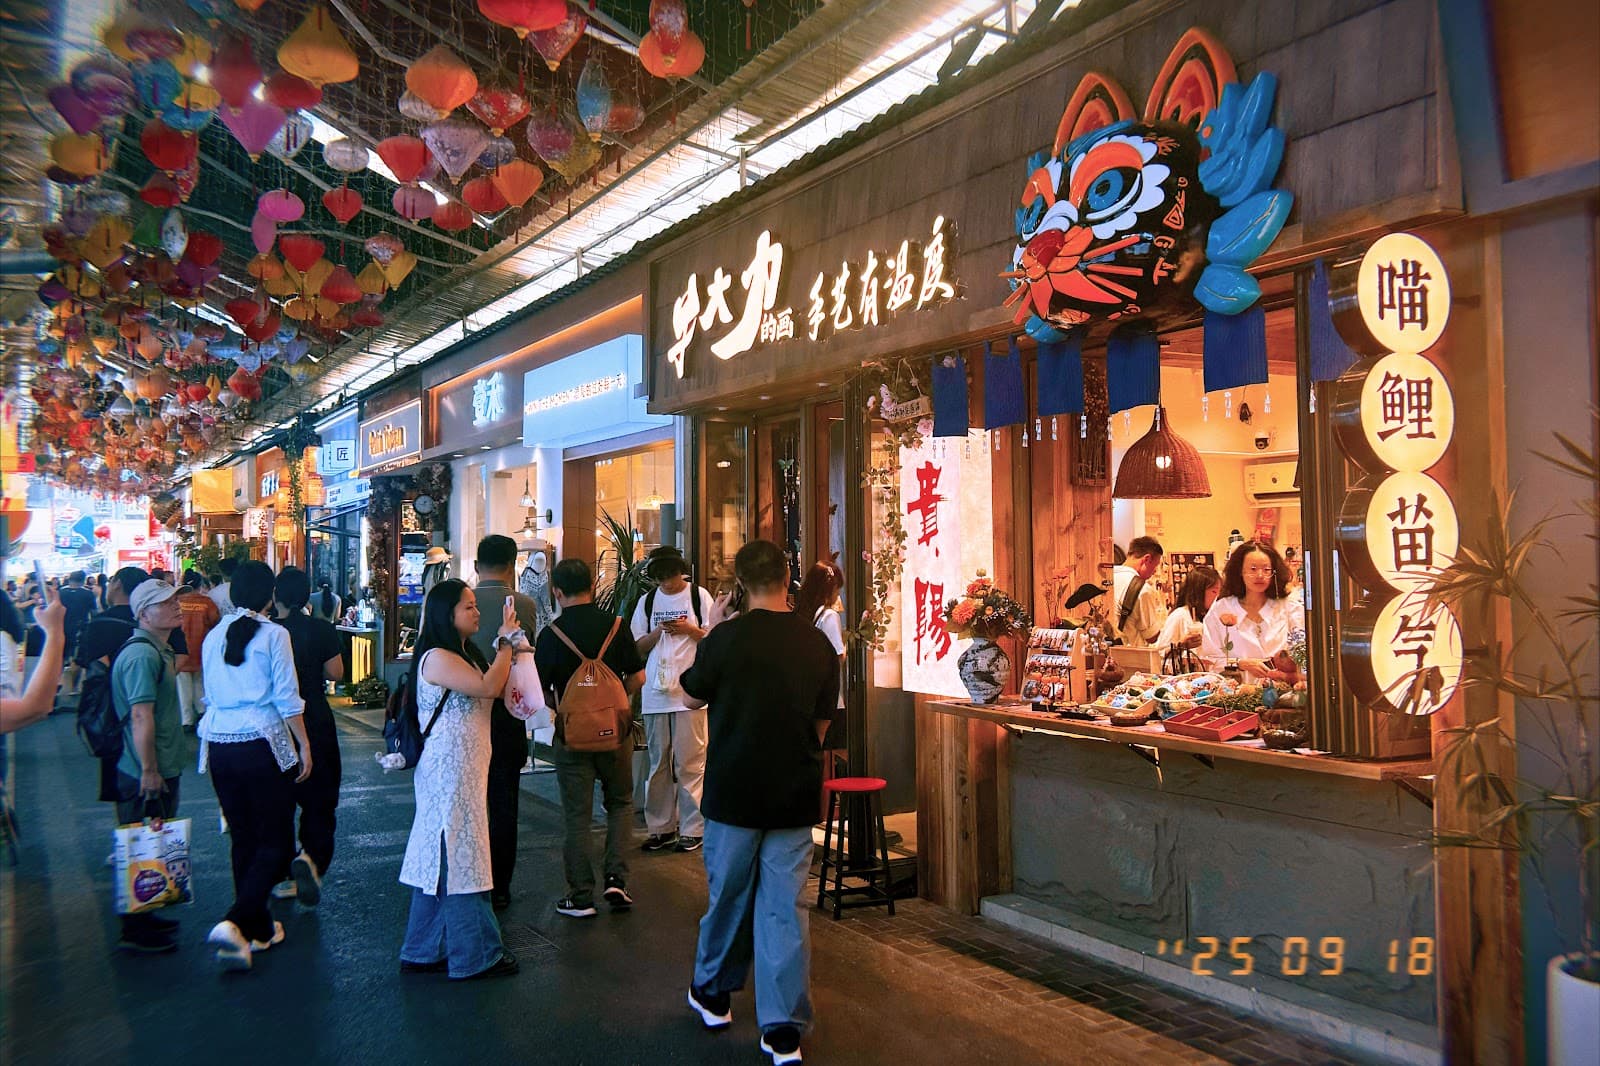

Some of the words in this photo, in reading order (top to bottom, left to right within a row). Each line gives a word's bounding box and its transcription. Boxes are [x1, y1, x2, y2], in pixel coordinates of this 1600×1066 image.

[808, 214, 955, 342] 手艺有温度
[336, 447, 349, 461] 匠
